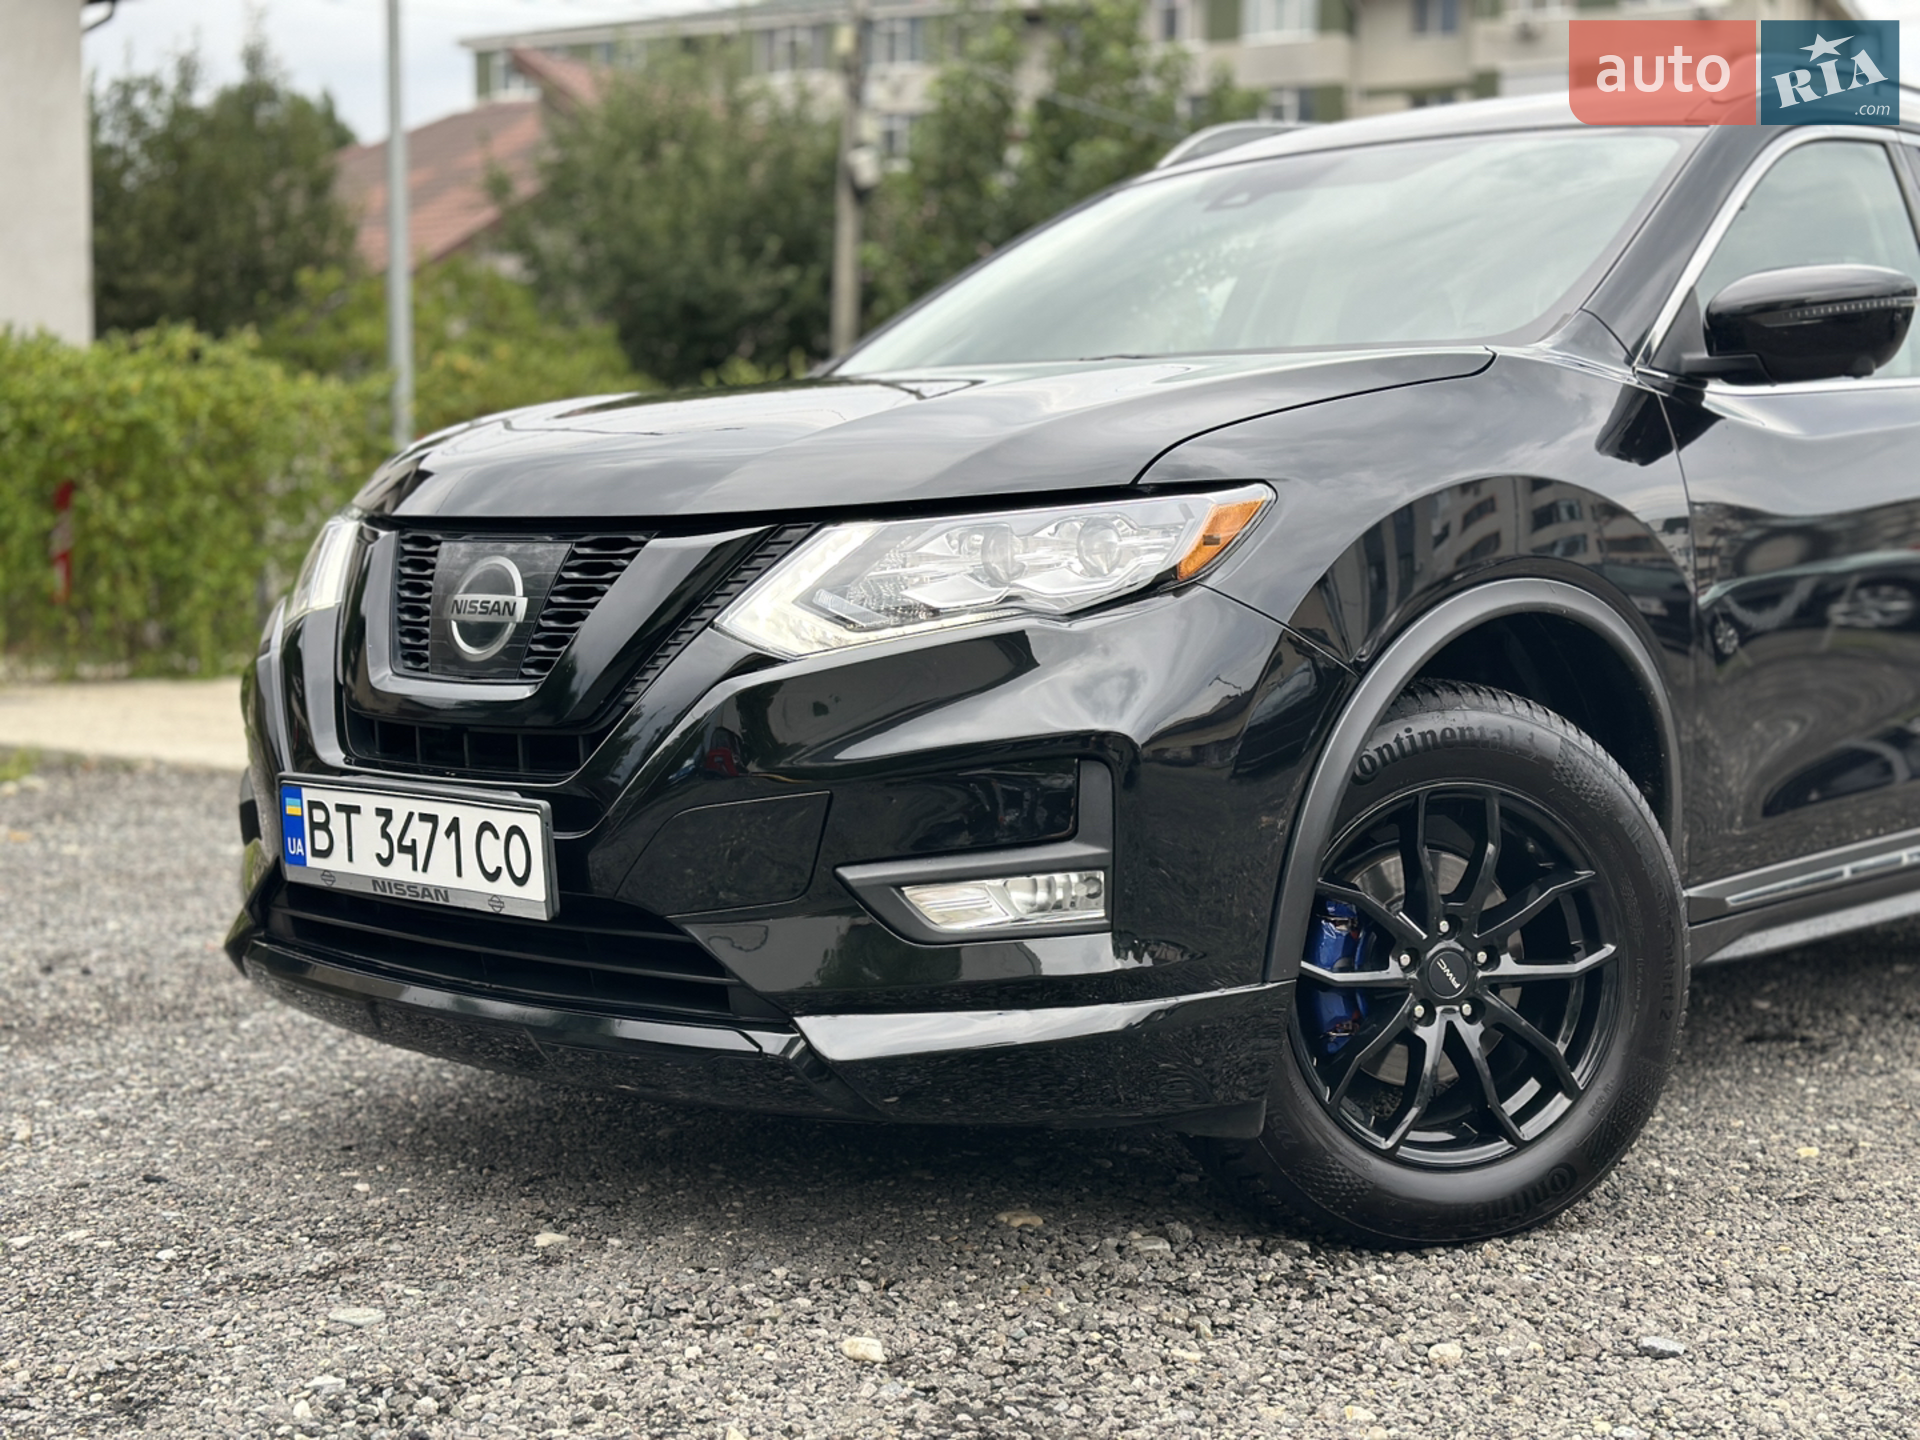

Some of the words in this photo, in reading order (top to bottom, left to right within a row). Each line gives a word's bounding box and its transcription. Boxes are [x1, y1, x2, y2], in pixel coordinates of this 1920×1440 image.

[451, 599, 517, 617] NISSAN
[287, 836, 305, 856] UA
[307, 799, 361, 863] BT
[374, 806, 463, 878] 3471
[475, 820, 532, 887] CO
[372, 879, 450, 903] NISSAN
